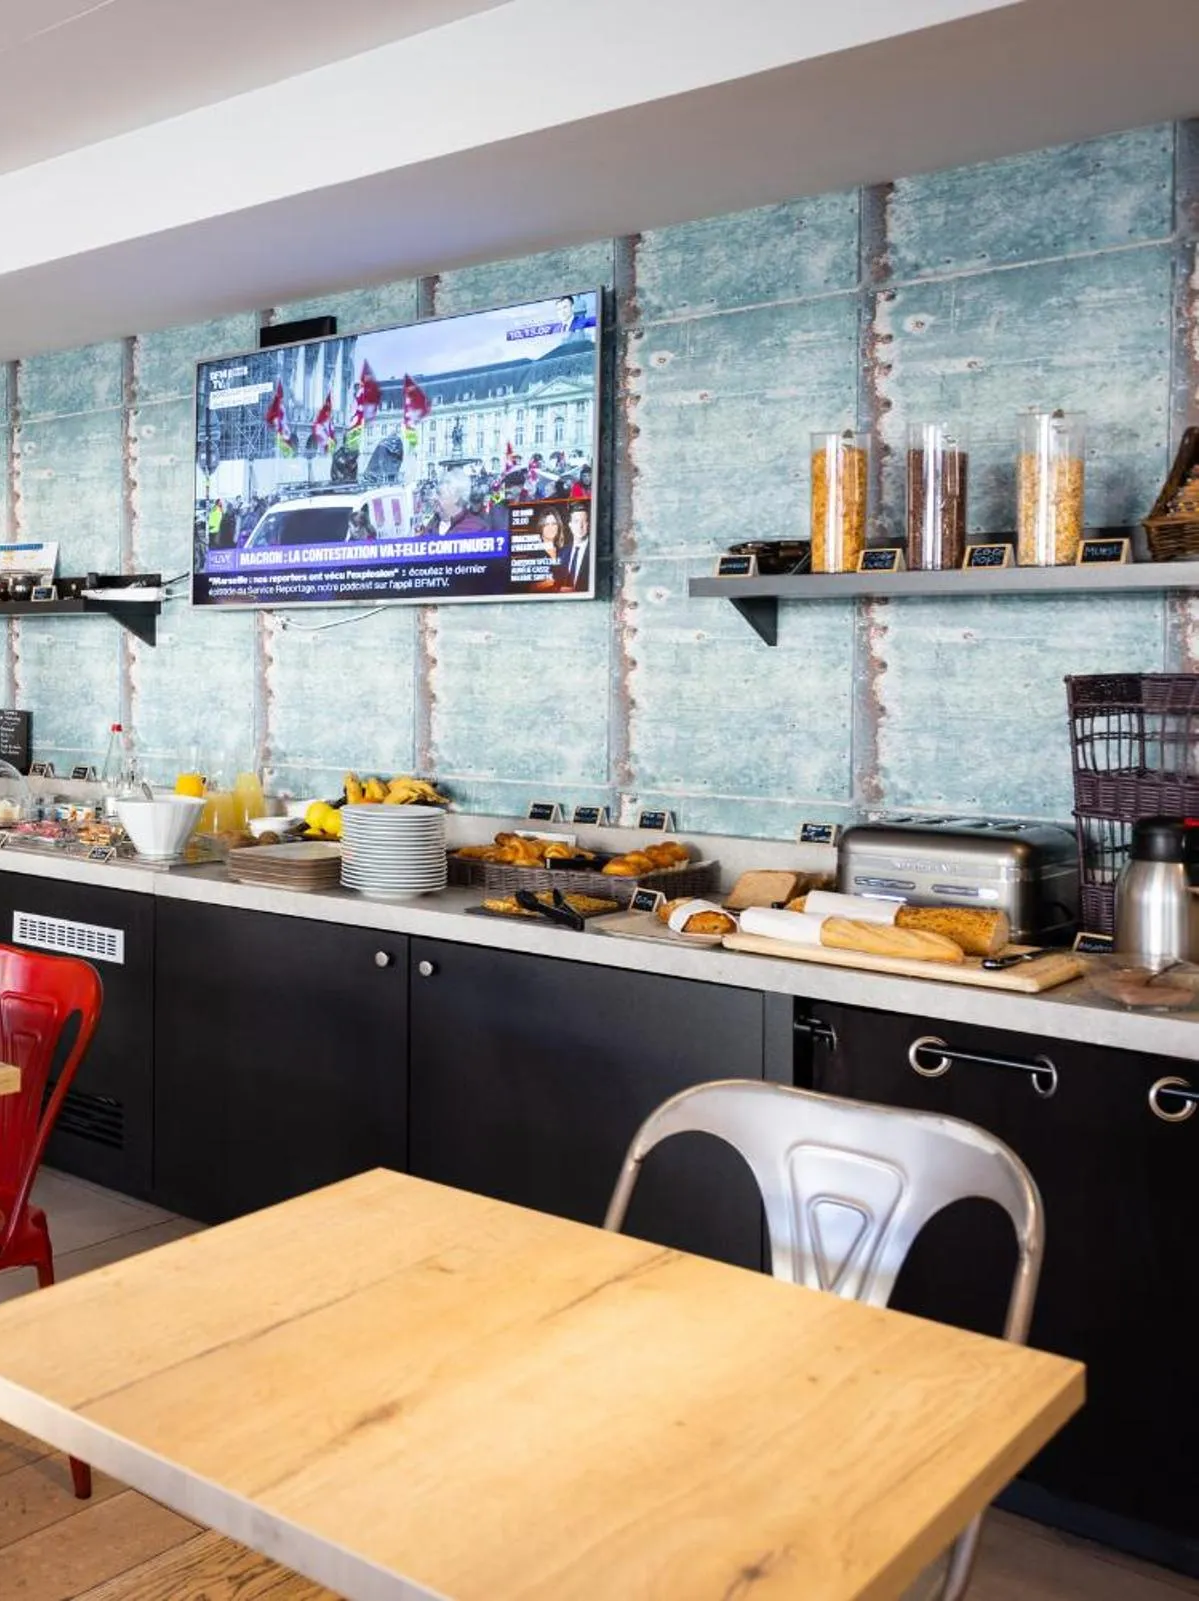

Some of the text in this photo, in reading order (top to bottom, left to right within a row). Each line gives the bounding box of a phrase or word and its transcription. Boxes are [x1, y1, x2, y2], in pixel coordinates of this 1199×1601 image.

[240, 550, 283, 566] MACRON
[288, 550, 301, 562] LA
[303, 545, 378, 561] CONTESTATION
[428, 537, 495, 556] CONTINUER
[269, 573, 307, 584] reporters
[308, 571, 323, 581] ont
[324, 570, 345, 580] vécu
[408, 567, 444, 577] écoutez
[454, 564, 487, 575] dernier
[339, 580, 373, 593] podcast
[373, 581, 388, 590] sur
[414, 577, 450, 588] BFMTV.
